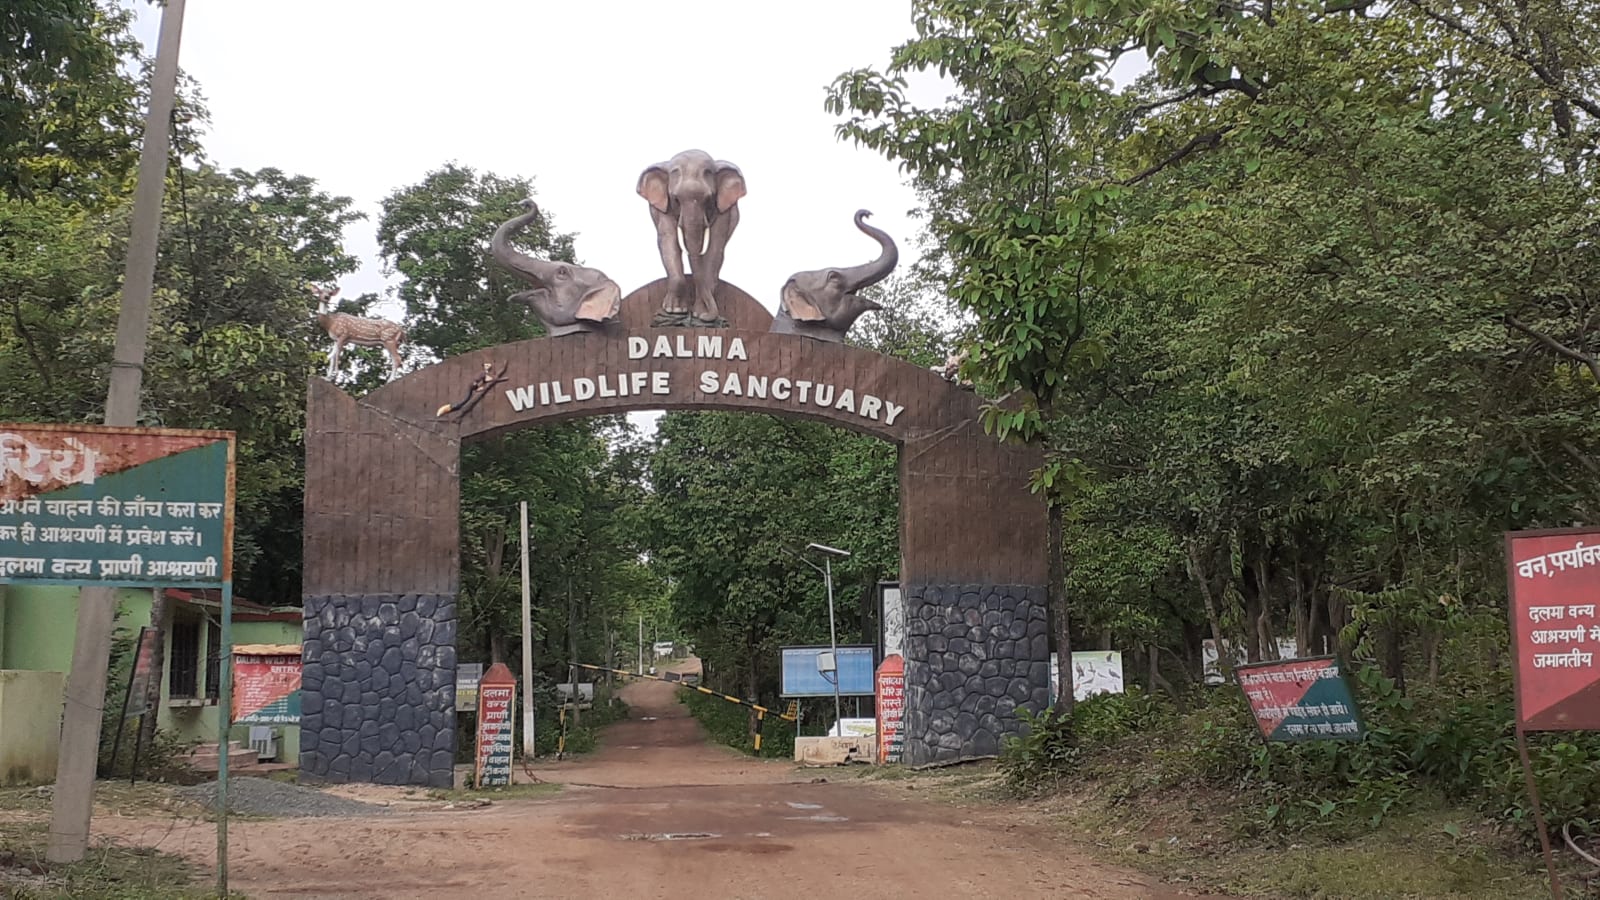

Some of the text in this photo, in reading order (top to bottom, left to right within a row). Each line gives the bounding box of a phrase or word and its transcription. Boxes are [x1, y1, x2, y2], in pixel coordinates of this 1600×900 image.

[627, 335, 748, 361] DALMA
[505, 370, 905, 426] WILDLIFE SANCTUARY
[45, 500, 93, 521] वाहन
[96, 495, 121, 516] की
[166, 502, 196, 518] करा
[198, 502, 223, 519] कर
[20, 521, 36, 546] ही
[39, 524, 106, 543] आश्रयणी
[108, 524, 124, 544] में
[126, 525, 167, 546] प्रवेश
[51, 558, 92, 575] वन्य
[98, 553, 143, 577] प्राणी
[147, 556, 218, 577] आश्रयणी
[1529, 604, 1595, 623] दलमा वन्य
[1530, 624, 1586, 644] आश्रयणी
[1533, 647, 1593, 668] जमानतीय
[483, 689, 511, 699] दलमा
[486, 700, 509, 708] वन्य
[486, 709, 509, 720] प्राणी
